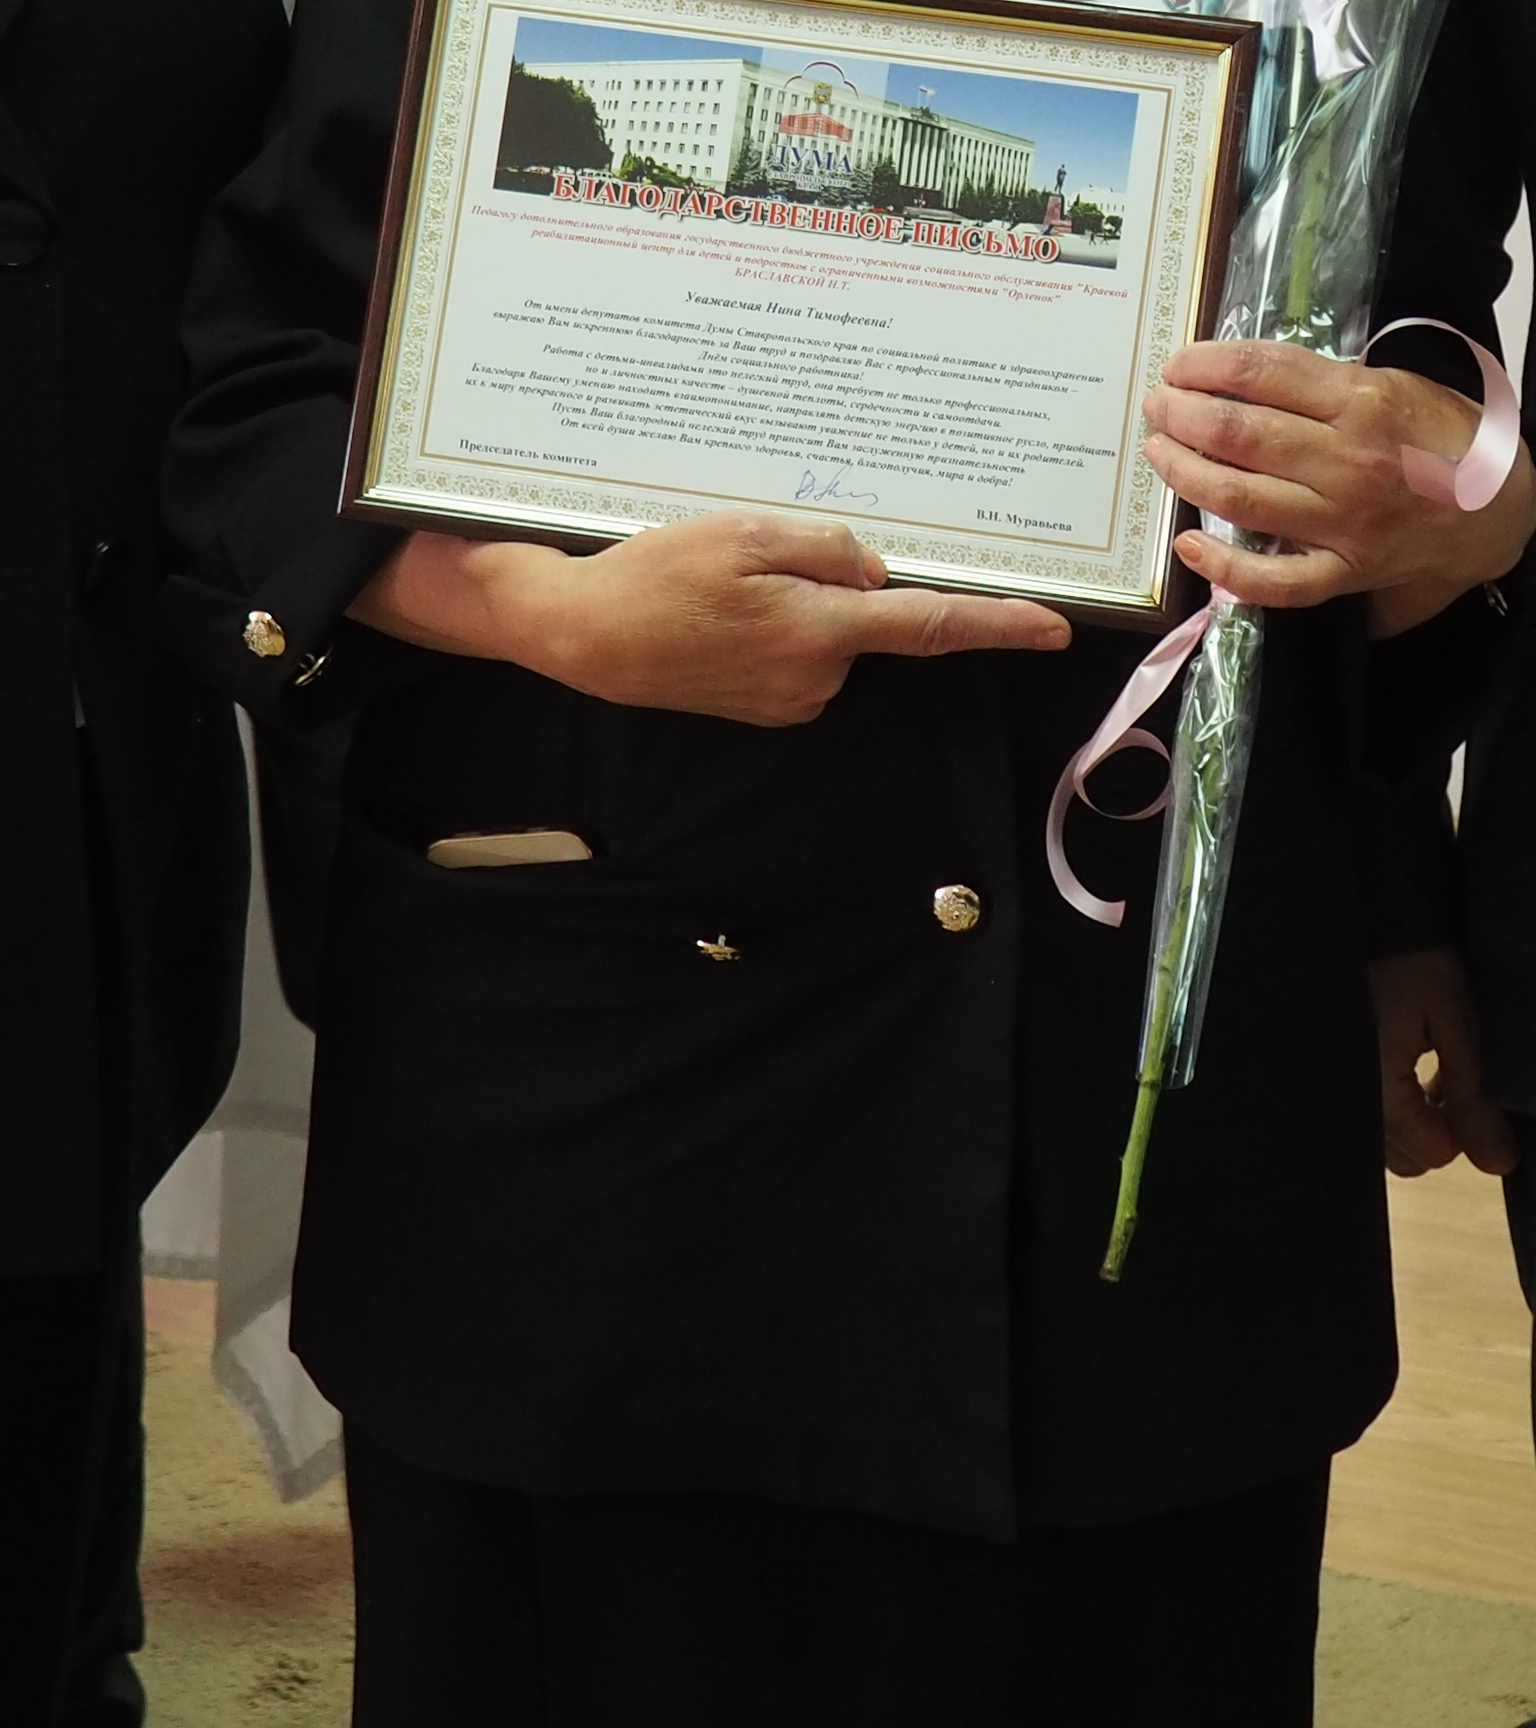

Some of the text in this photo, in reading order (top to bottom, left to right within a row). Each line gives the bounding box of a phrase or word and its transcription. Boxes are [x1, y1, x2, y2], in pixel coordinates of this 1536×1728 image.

[767, 145, 853, 174] ДУМА
[554, 173, 1060, 263] БЛАГОДАРСТВЕННОЕ ПИСЬМО
[685, 290, 762, 312] Уважаемая
[765, 301, 802, 317] Нина
[492, 311, 545, 324] выражаю
[547, 315, 570, 327] Вам
[572, 321, 634, 336] искреннюю
[635, 327, 716, 347] благодарность
[718, 340, 730, 349] за
[731, 339, 757, 352] Ваш
[758, 346, 787, 358] труд
[798, 351, 862, 366] поздравляю
[864, 357, 885, 369] Вас
[894, 364, 1001, 385] профессиональным
[1003, 378, 1069, 394] праздником
[523, 298, 542, 310] От
[544, 303, 579, 315] имени
[580, 307, 641, 323] депутатов
[642, 317, 701, 331] комитета
[701, 321, 734, 336] Думы
[736, 326, 831, 348] Ставропольского
[832, 341, 858, 352] края
[860, 345, 875, 353] по
[876, 347, 940, 362] социальной
[941, 356, 998, 370] политике
[1008, 364, 1104, 384] здравоохранению
[696, 350, 728, 363] Днём
[729, 356, 797, 372] социального
[542, 343, 584, 358] Работа
[593, 351, 705, 374] детьми-инвалидами
[706, 367, 728, 377] это
[729, 370, 779, 384] нелегкий
[813, 382, 834, 391] она
[835, 384, 884, 398] требует
[885, 391, 900, 400] не
[900, 393, 942, 406] только
[584, 365, 599, 374] но
[609, 369, 680, 385] личностных
[680, 378, 726, 391] качеств
[736, 384, 790, 400] душевной
[849, 401, 920, 417] сердечности
[464, 377, 479, 386] их
[488, 381, 517, 393] миру
[517, 385, 584, 401] прекрасного
[593, 395, 651, 409] развивать
[652, 403, 732, 420] эстетический
[733, 414, 758, 425] вкус
[759, 417, 817, 432] вызывают
[817, 425, 874, 440] уважение
[874, 433, 889, 441] не
[890, 435, 931, 447] только
[980, 447, 995, 456] но
[1007, 450, 1022, 459] их
[471, 361, 526, 380] Благодаря
[528, 370, 572, 387] Вашему
[571, 378, 616, 390] умению
[617, 384, 671, 398] находить
[775, 405, 841, 421] направлять
[843, 412, 891, 428] детскую
[894, 421, 938, 434] энергию
[948, 428, 1015, 444] позитивное
[1051, 442, 1116, 458] приобщать
[551, 401, 1026, 474] Пусть Ваш благородный нелегкий труд приносит Вам заслуженную признательность
[459, 438, 597, 467] Председатель комитета
[560, 416, 579, 428] От
[580, 421, 605, 432] всей
[606, 424, 636, 436] души
[637, 429, 677, 441] желаю
[678, 432, 702, 445] Вам
[703, 438, 752, 451] крепкого
[935, 470, 965, 482] мира
[1004, 512, 1072, 532] Муравьева
